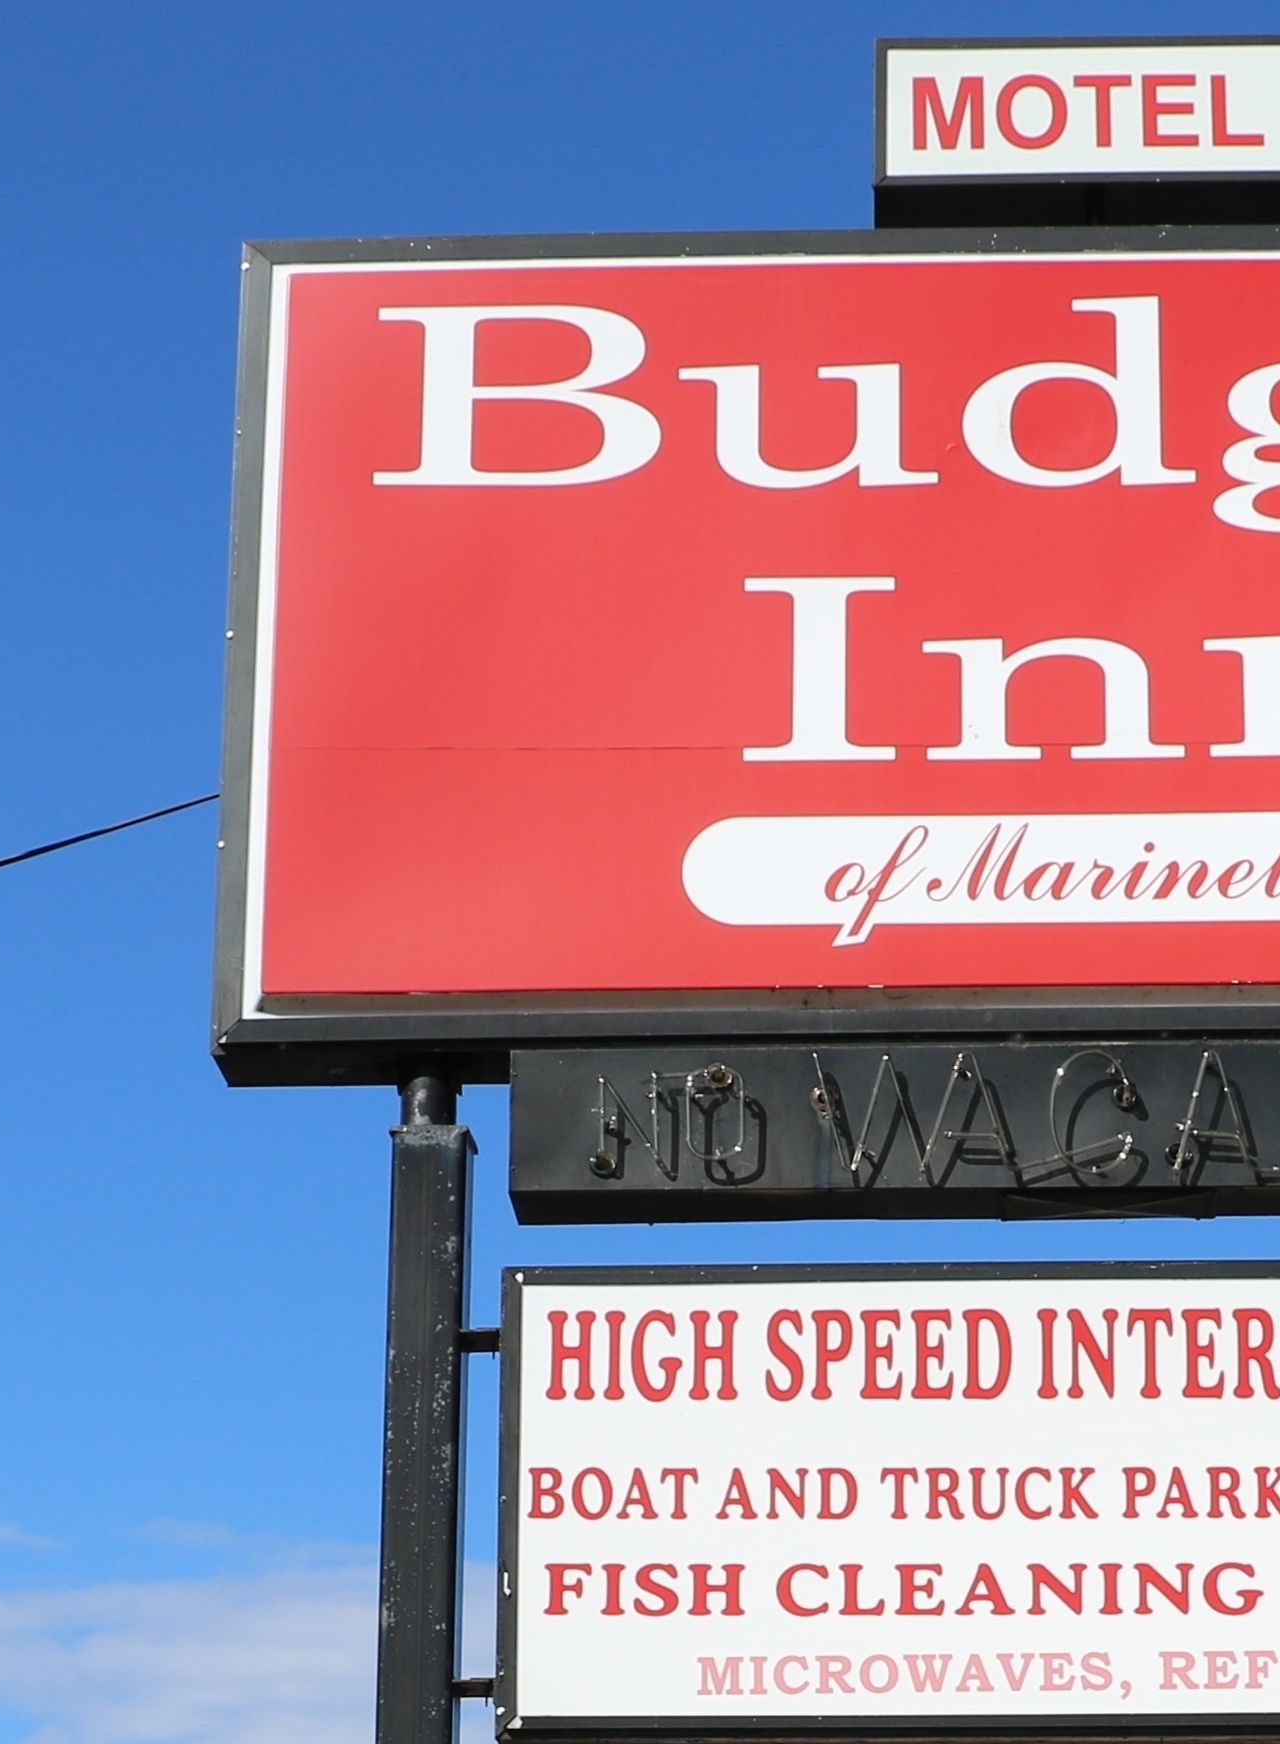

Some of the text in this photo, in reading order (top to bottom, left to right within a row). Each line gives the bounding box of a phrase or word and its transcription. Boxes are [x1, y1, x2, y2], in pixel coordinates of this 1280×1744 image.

[912, 73, 1265, 150] MOTEL
[824, 825, 926, 937] of
[590, 1062, 745, 1178] NO
[546, 1309, 739, 1402] HIGH
[766, 1308, 1013, 1402] SPEED
[529, 1466, 698, 1520] BOAT
[716, 1467, 858, 1520] AND
[881, 1466, 1099, 1520] TRUCK
[545, 1563, 745, 1617] FISH
[777, 1562, 1264, 1617] CLEANING
[697, 1653, 1132, 1697] MICROWAVES,
